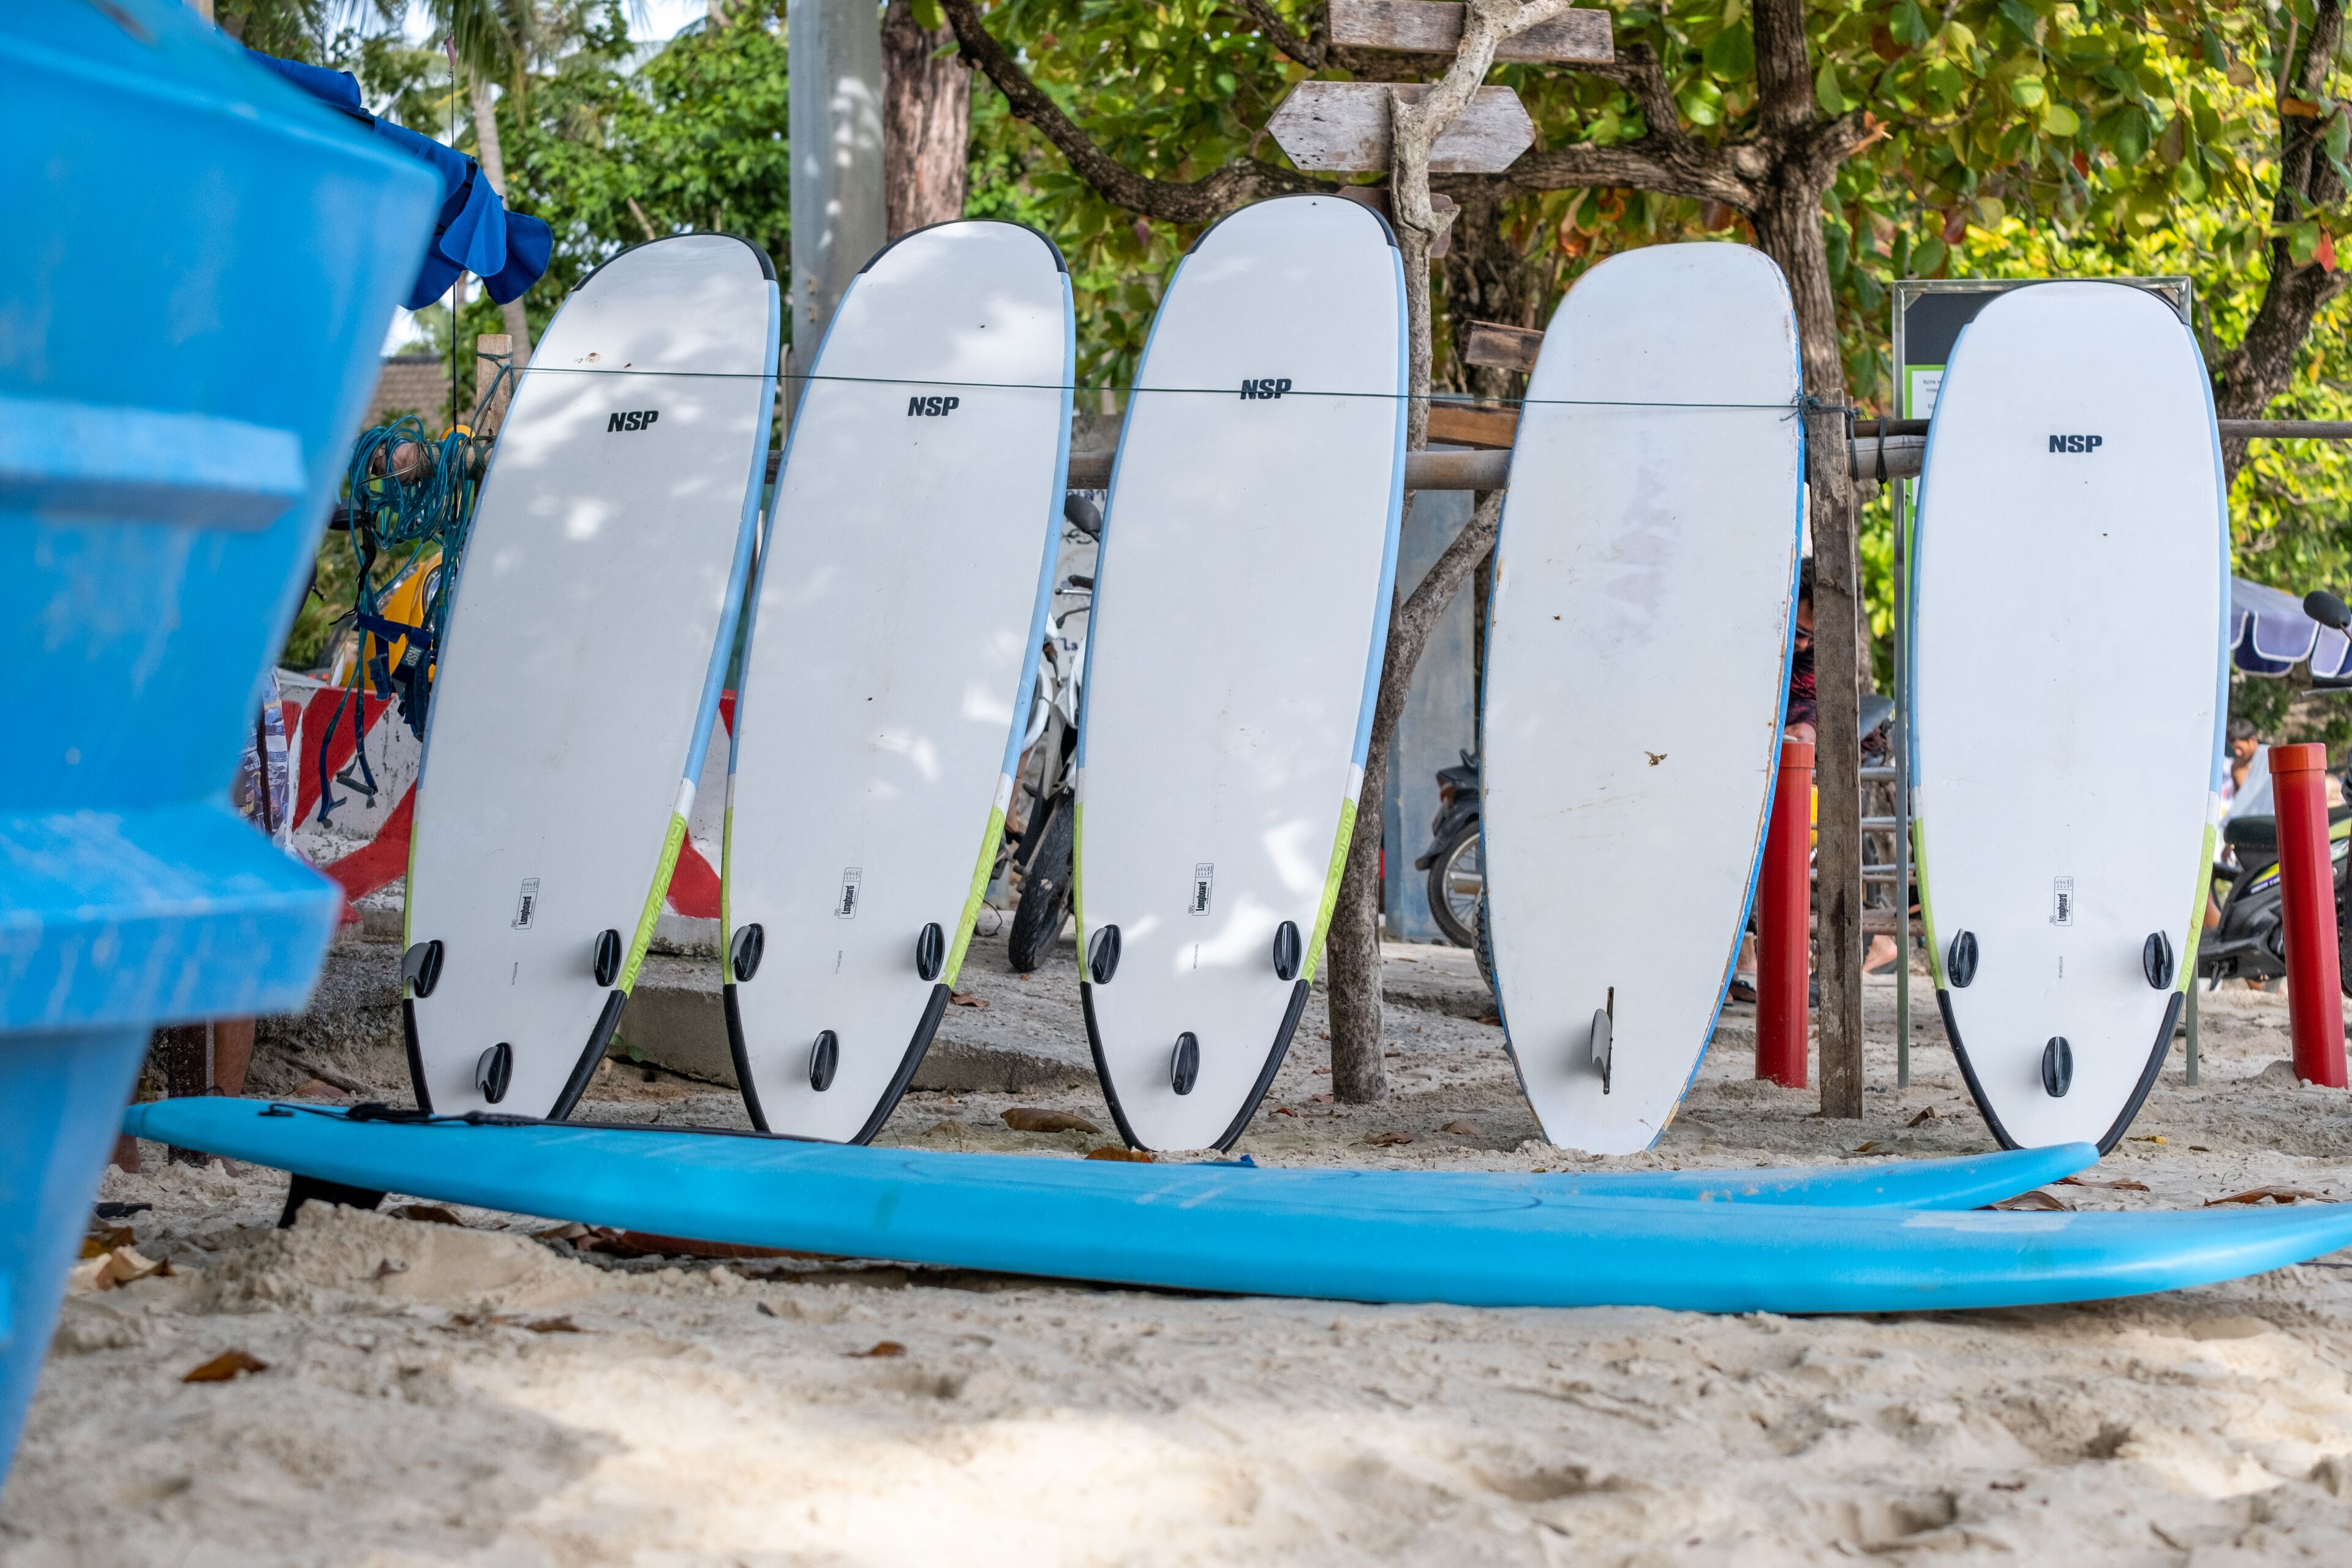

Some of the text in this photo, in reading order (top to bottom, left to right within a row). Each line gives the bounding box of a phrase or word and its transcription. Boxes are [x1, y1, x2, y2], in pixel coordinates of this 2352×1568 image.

[1240, 379, 1292, 399] NSP
[908, 396, 960, 417] NSP
[607, 410, 659, 432] NSP
[2049, 435, 2103, 453] NSP
[405, 646, 422, 666] NSP
[841, 885, 854, 914] Longboard
[1196, 881, 1207, 911] Longboard
[518, 896, 532, 925] Longboard
[2057, 894, 2068, 922] Longboard
